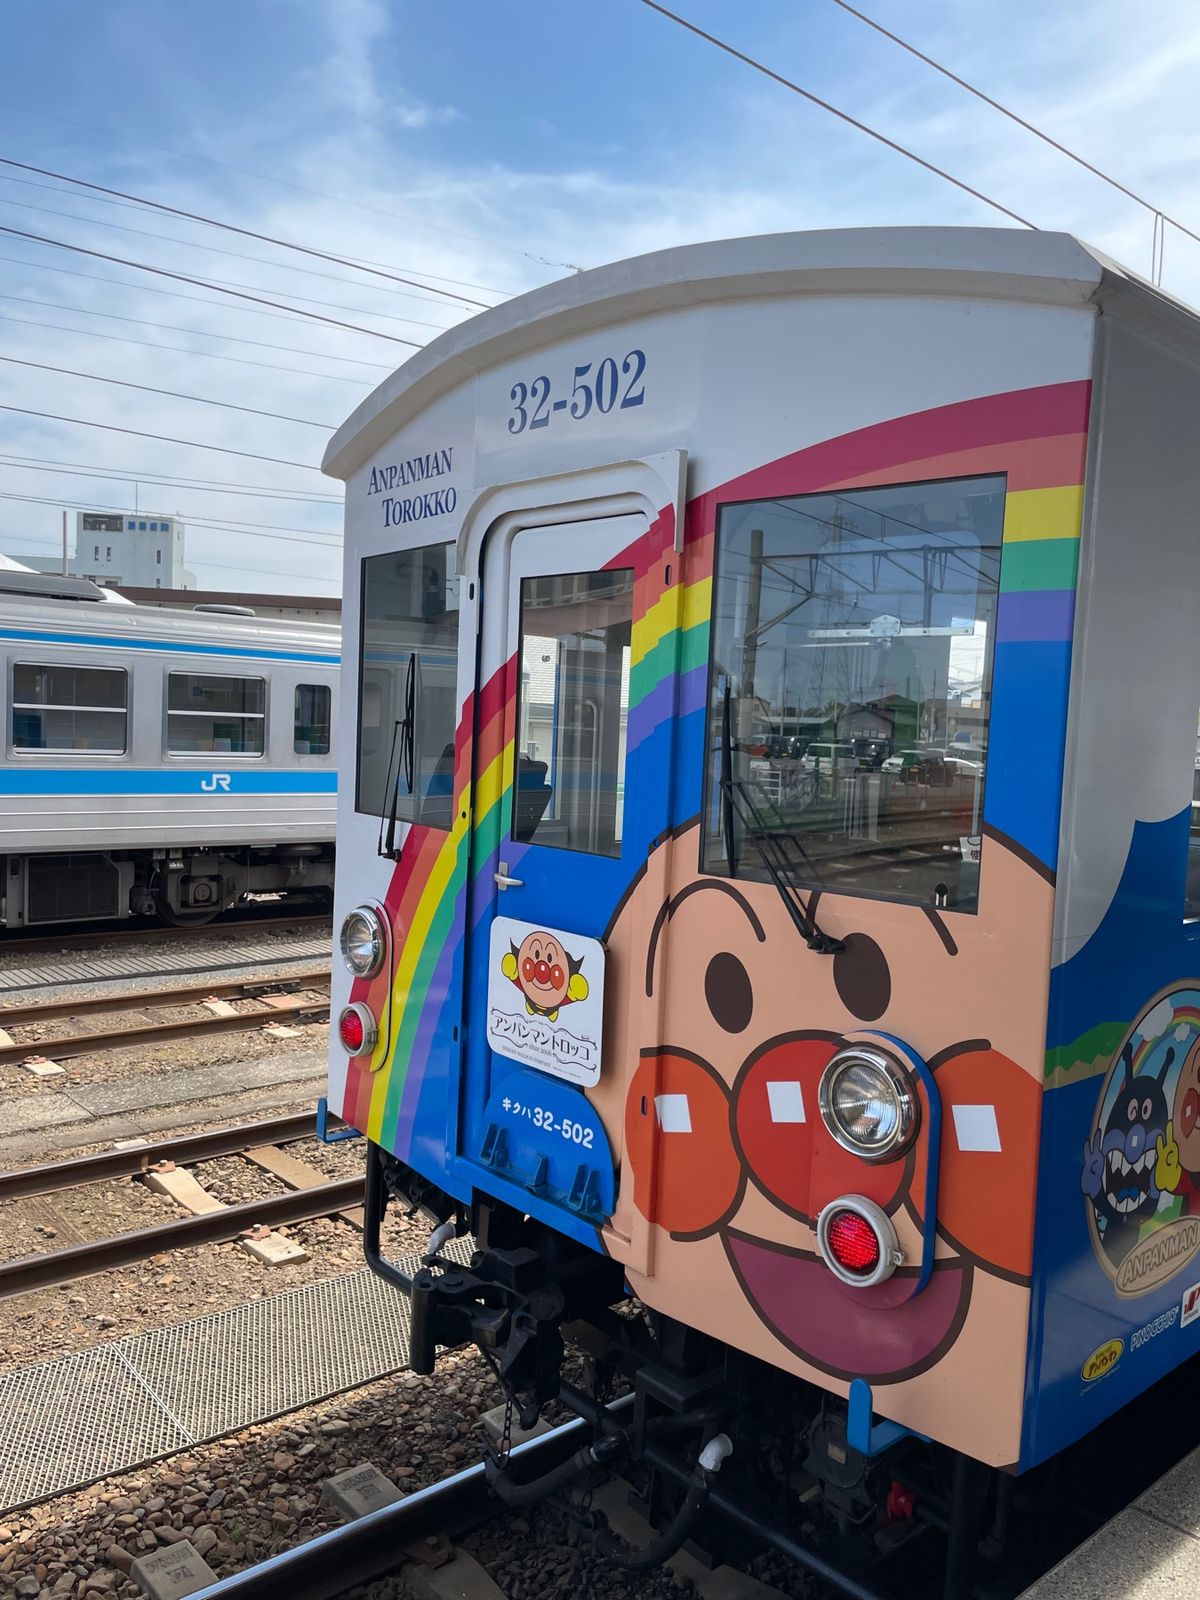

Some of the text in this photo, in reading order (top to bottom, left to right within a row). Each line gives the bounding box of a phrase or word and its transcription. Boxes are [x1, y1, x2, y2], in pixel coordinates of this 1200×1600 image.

[508, 349, 646, 434] 32-502
[367, 447, 453, 495] ANPANMAN
[382, 487, 456, 527] TOROKKO
[201, 773, 231, 791] JR
[494, 1017, 590, 1061] アンパンマントロッコ
[1122, 1222, 1199, 1288] ANPANMAN
